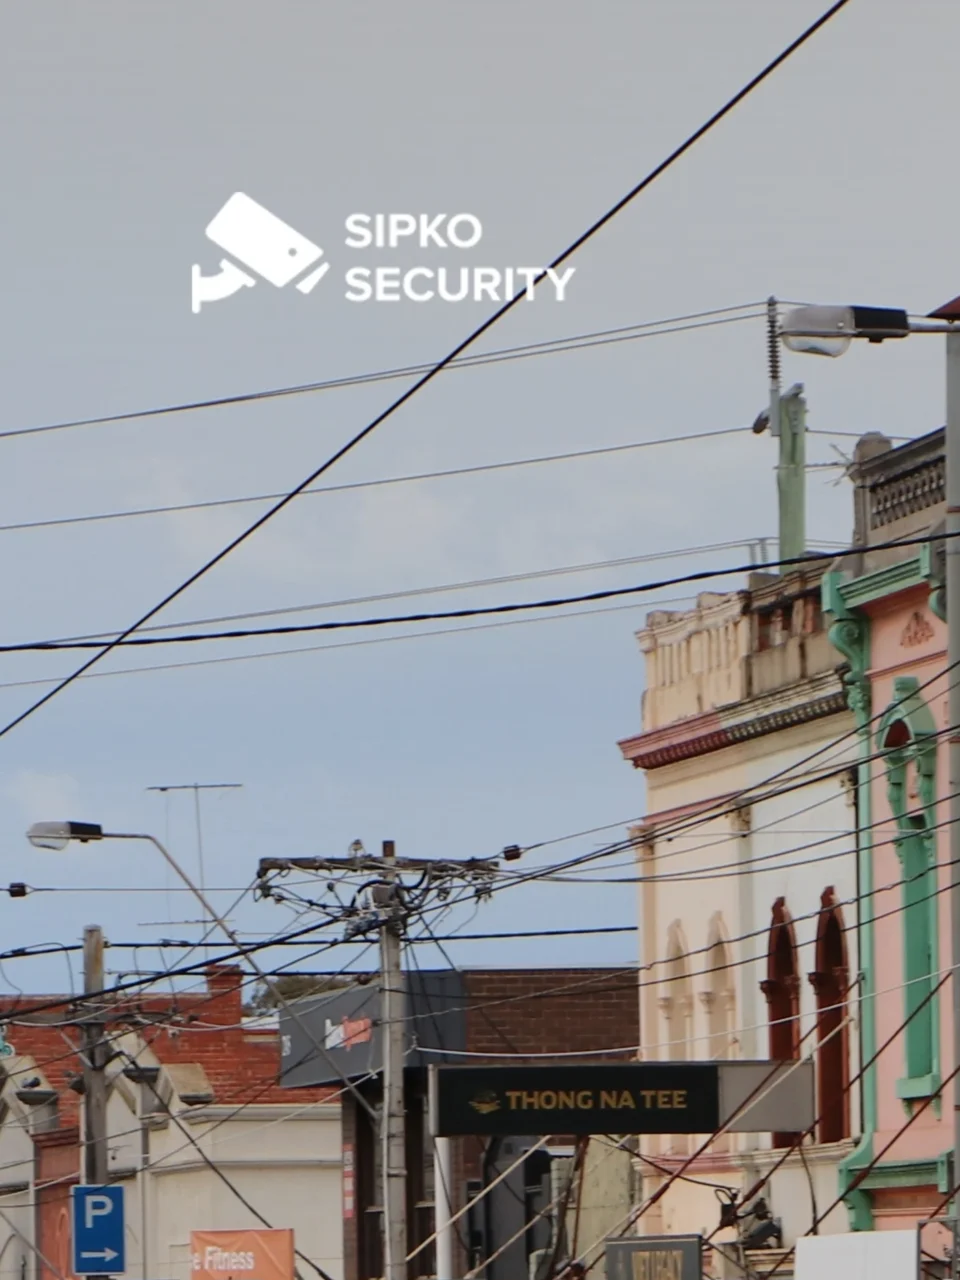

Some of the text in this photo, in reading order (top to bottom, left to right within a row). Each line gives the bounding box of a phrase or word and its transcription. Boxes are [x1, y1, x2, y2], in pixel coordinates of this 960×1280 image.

[505, 1089, 688, 1110] THONG NA TEE
[84, 1195, 114, 1229] P
[204, 1245, 255, 1271] Fitness
